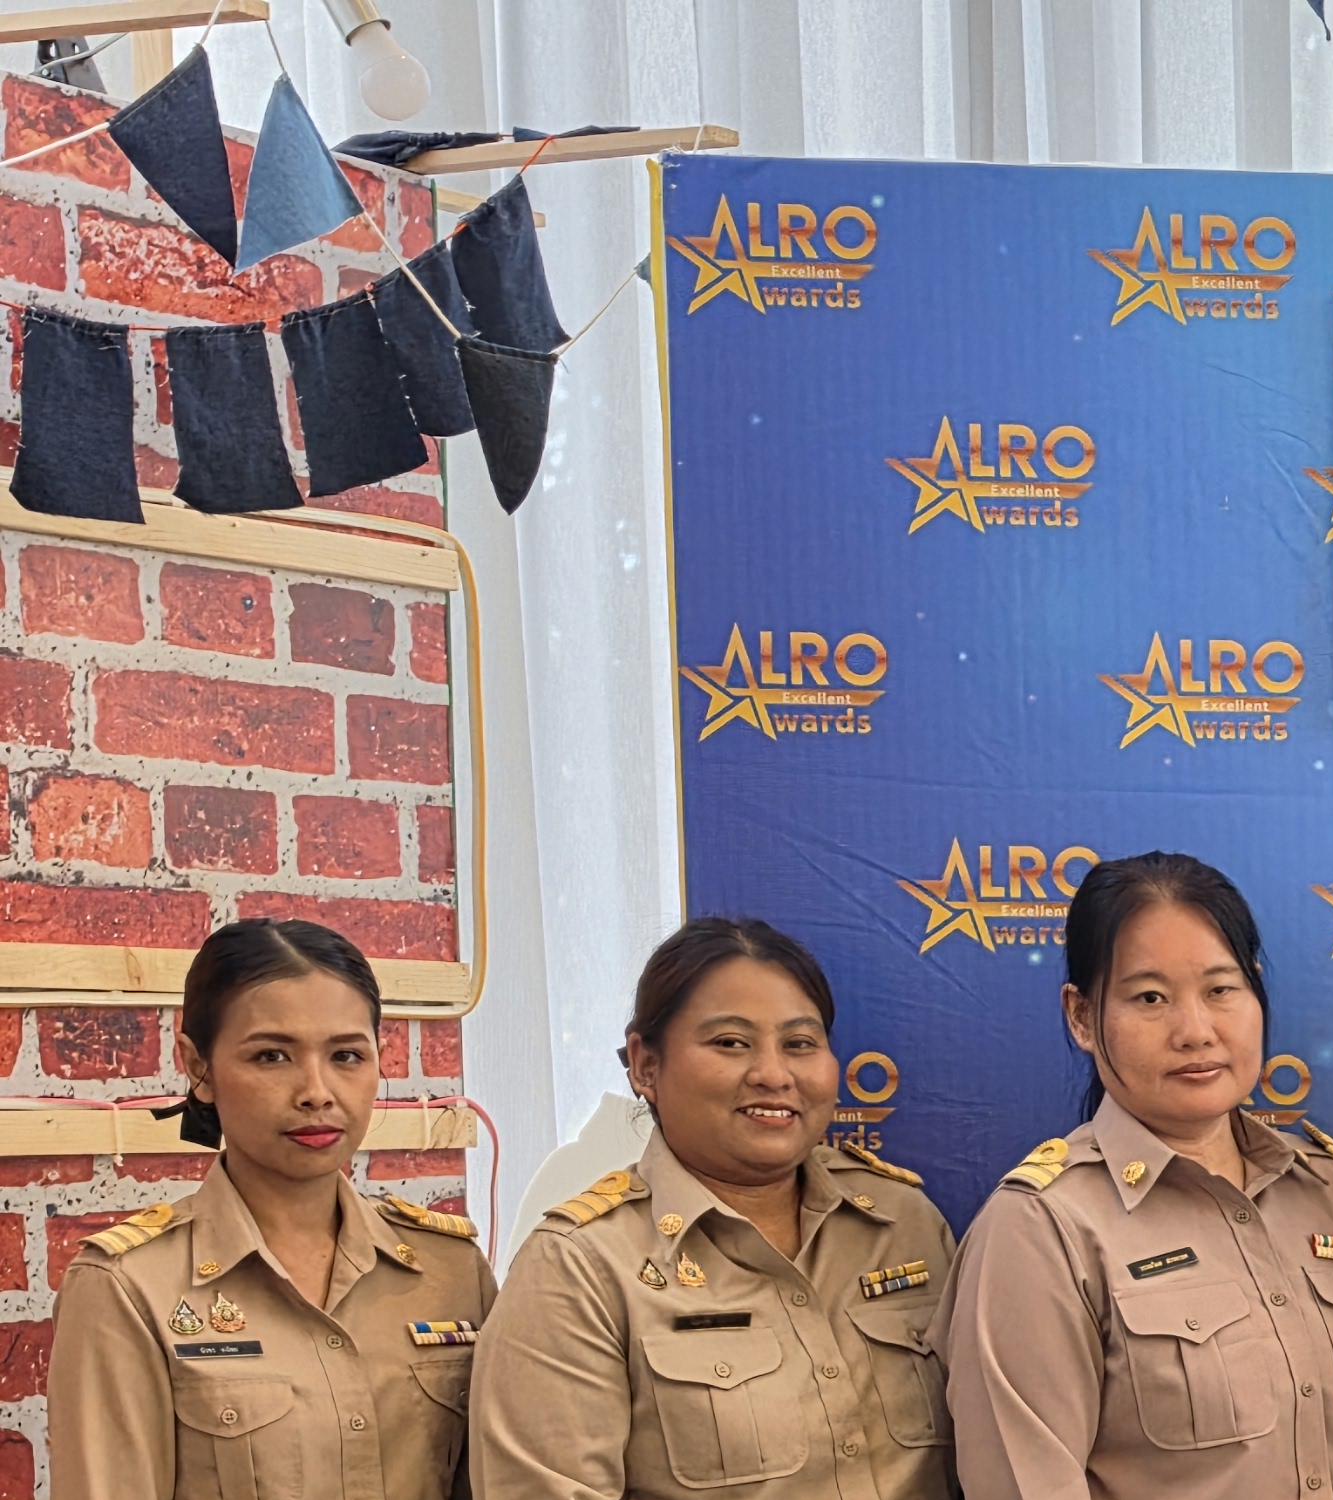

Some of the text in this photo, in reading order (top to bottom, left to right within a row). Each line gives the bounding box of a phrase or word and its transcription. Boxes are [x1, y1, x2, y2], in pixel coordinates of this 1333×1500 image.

[667, 193, 877, 267] ALRO
[1086, 206, 1296, 279] ALRO
[771, 264, 842, 279] Excellent
[1192, 276, 1261, 290] Excellent
[884, 415, 1096, 487] ALRO
[990, 484, 1060, 499] Excellent
[677, 623, 888, 695] ALRO
[1096, 631, 1305, 702] ALRO
[782, 691, 852, 705] Excellent
[1201, 700, 1269, 712] Excellent
[1001, 904, 1068, 917] Excellent
